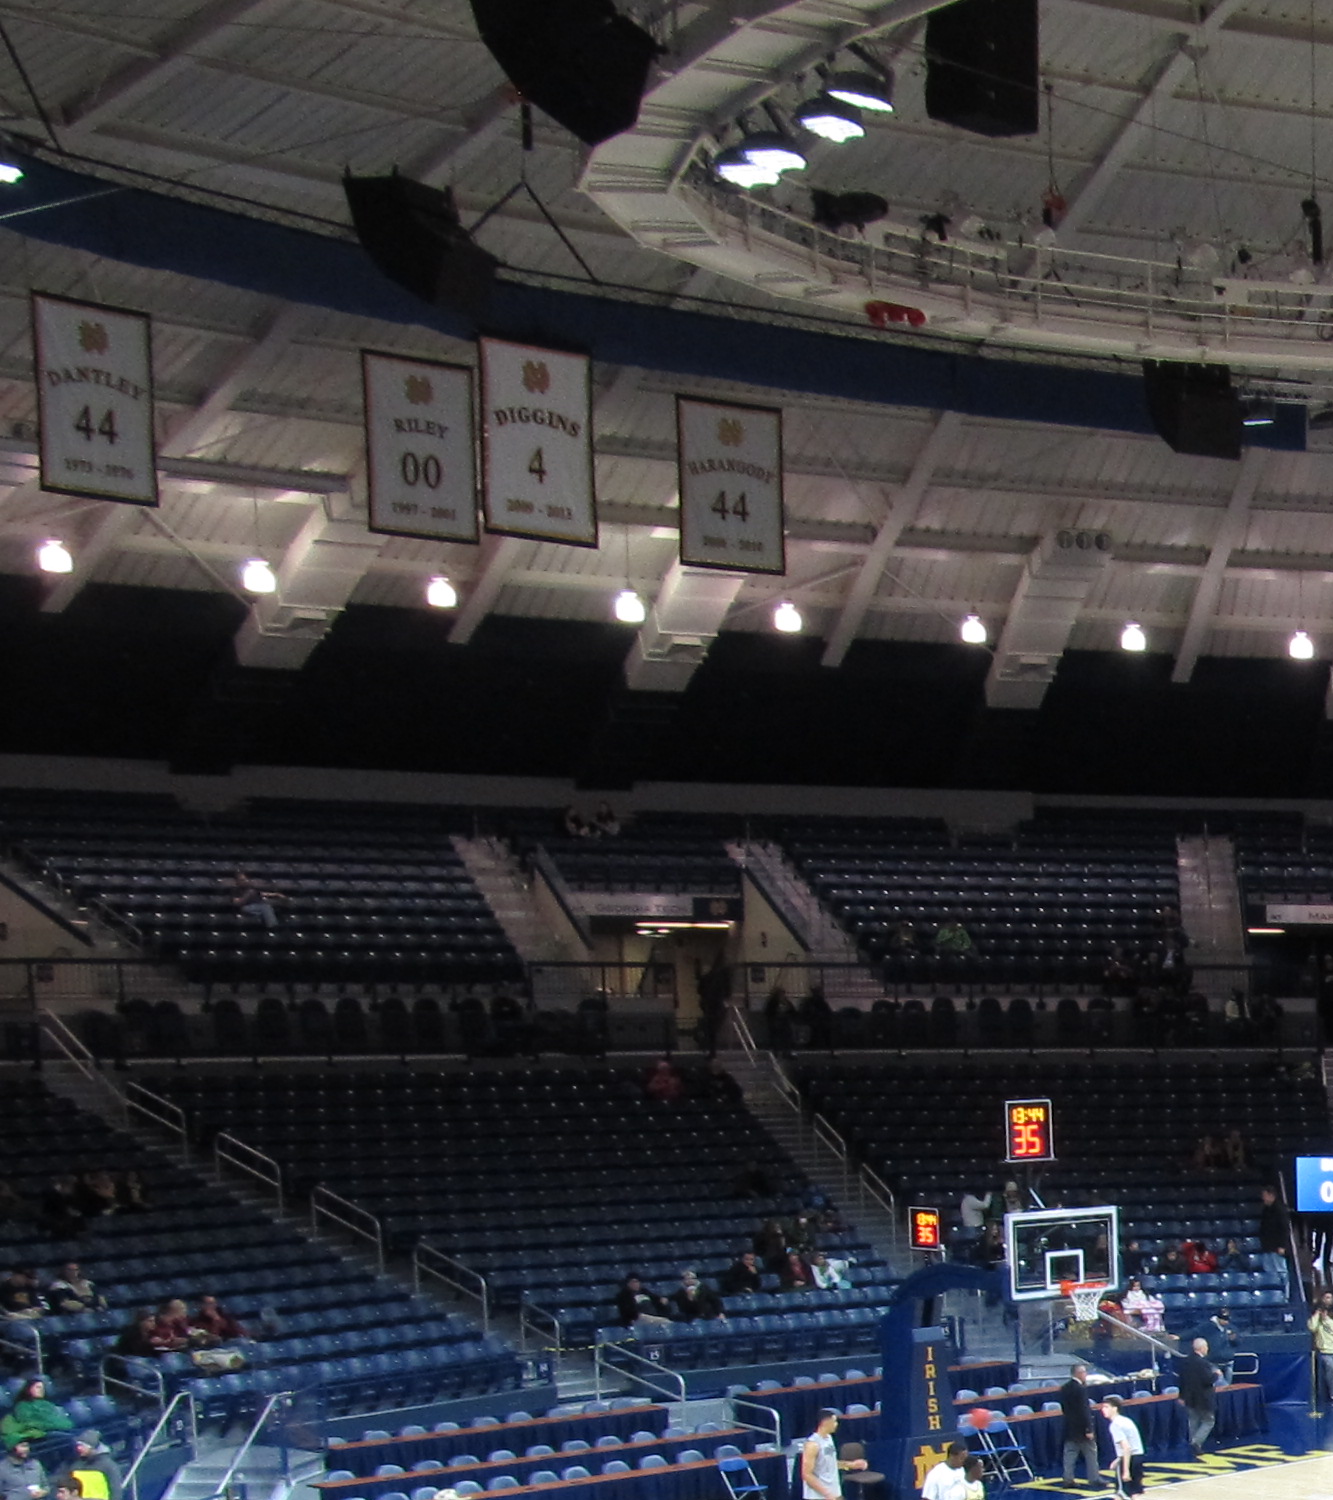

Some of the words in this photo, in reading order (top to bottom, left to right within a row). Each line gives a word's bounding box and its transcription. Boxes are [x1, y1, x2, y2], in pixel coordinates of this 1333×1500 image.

[46, 366, 149, 401] DANTLEY
[74, 404, 118, 445] 44
[393, 417, 449, 440] RILEY
[494, 406, 581, 438] DIGGINS
[402, 452, 442, 489] 00
[528, 446, 547, 484] 4
[711, 490, 750, 523] 44
[1011, 1106, 1045, 1124] 13:44
[1012, 1124, 1042, 1156] 35
[917, 1226, 935, 1244] 35
[923, 1346, 942, 1431] IRISH
